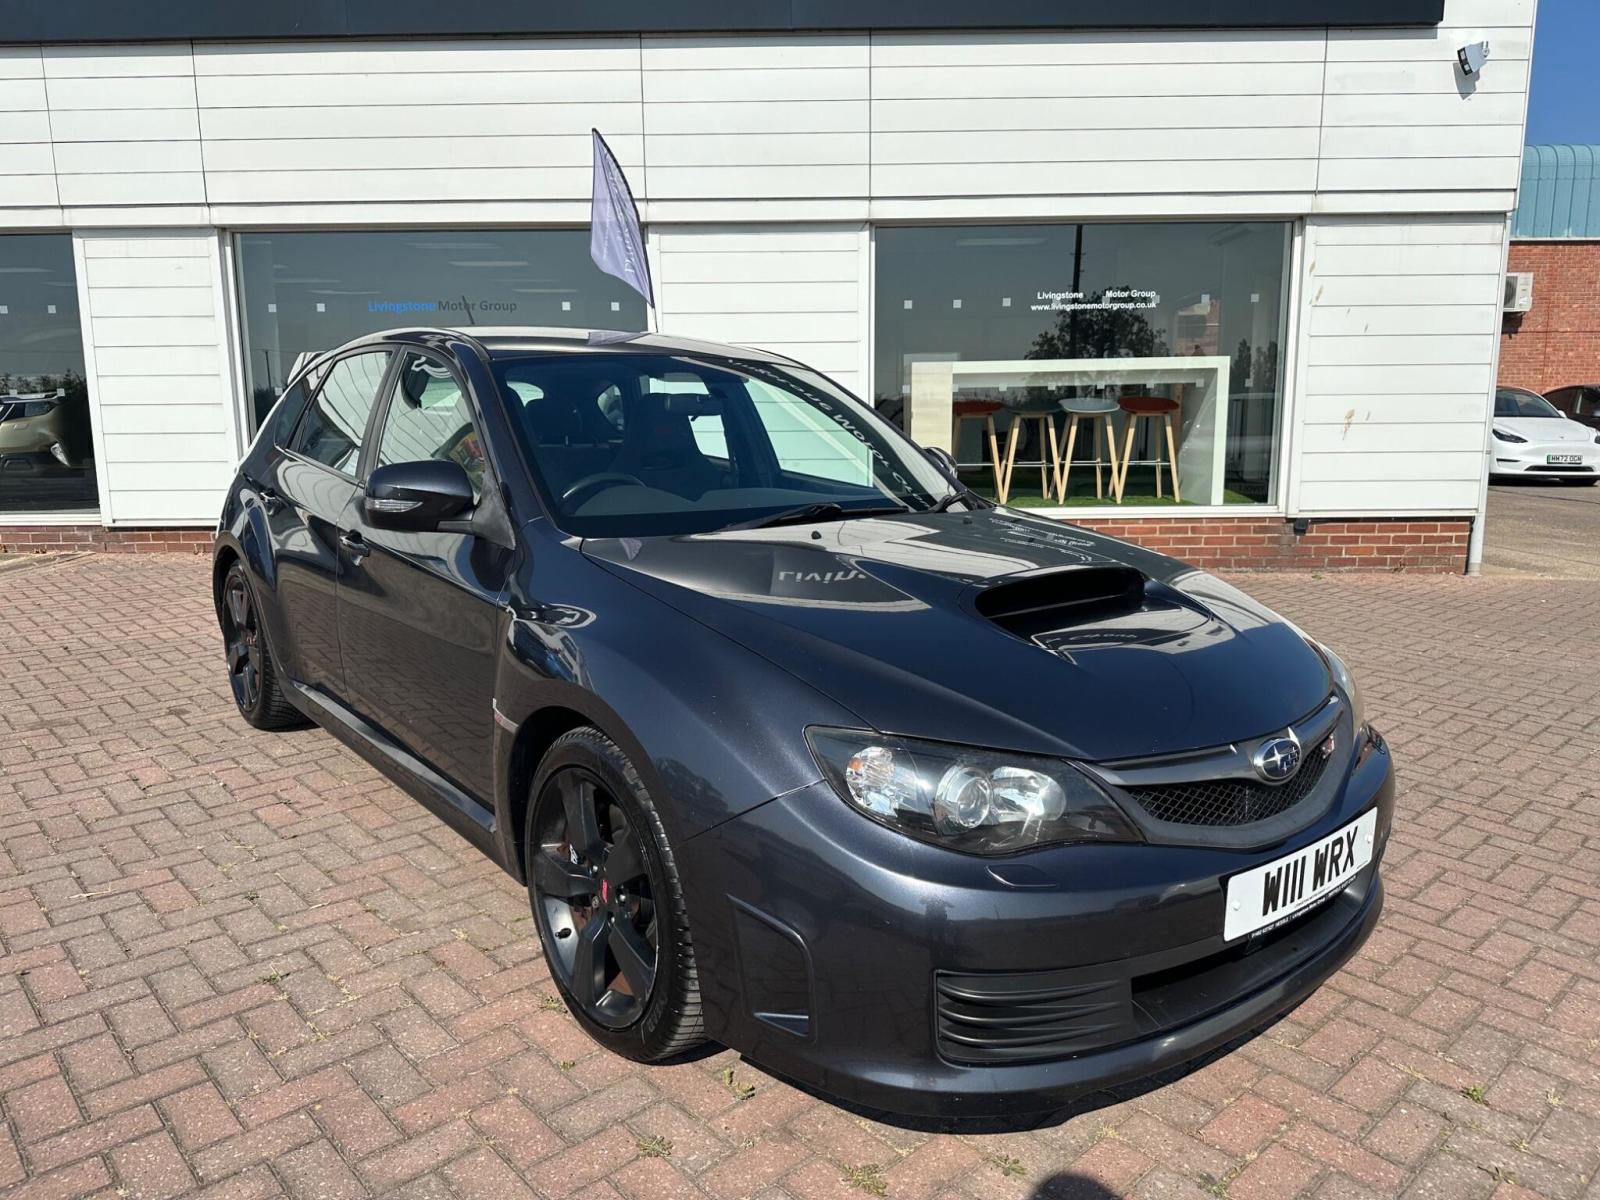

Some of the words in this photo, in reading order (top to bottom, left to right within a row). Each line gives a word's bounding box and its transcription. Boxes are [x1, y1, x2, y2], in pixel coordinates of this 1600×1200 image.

[1037, 291, 1084, 301] Livingstone
[1105, 290, 1130, 298] Motor
[1131, 289, 1156, 299] Group
[368, 301, 436, 313] Livingstone
[438, 301, 476, 311] Motor
[479, 301, 517, 313] Group
[1031, 302, 1157, 311] www.livingstonemotorgroup.co.uk
[1312, 825, 1359, 892] WRX
